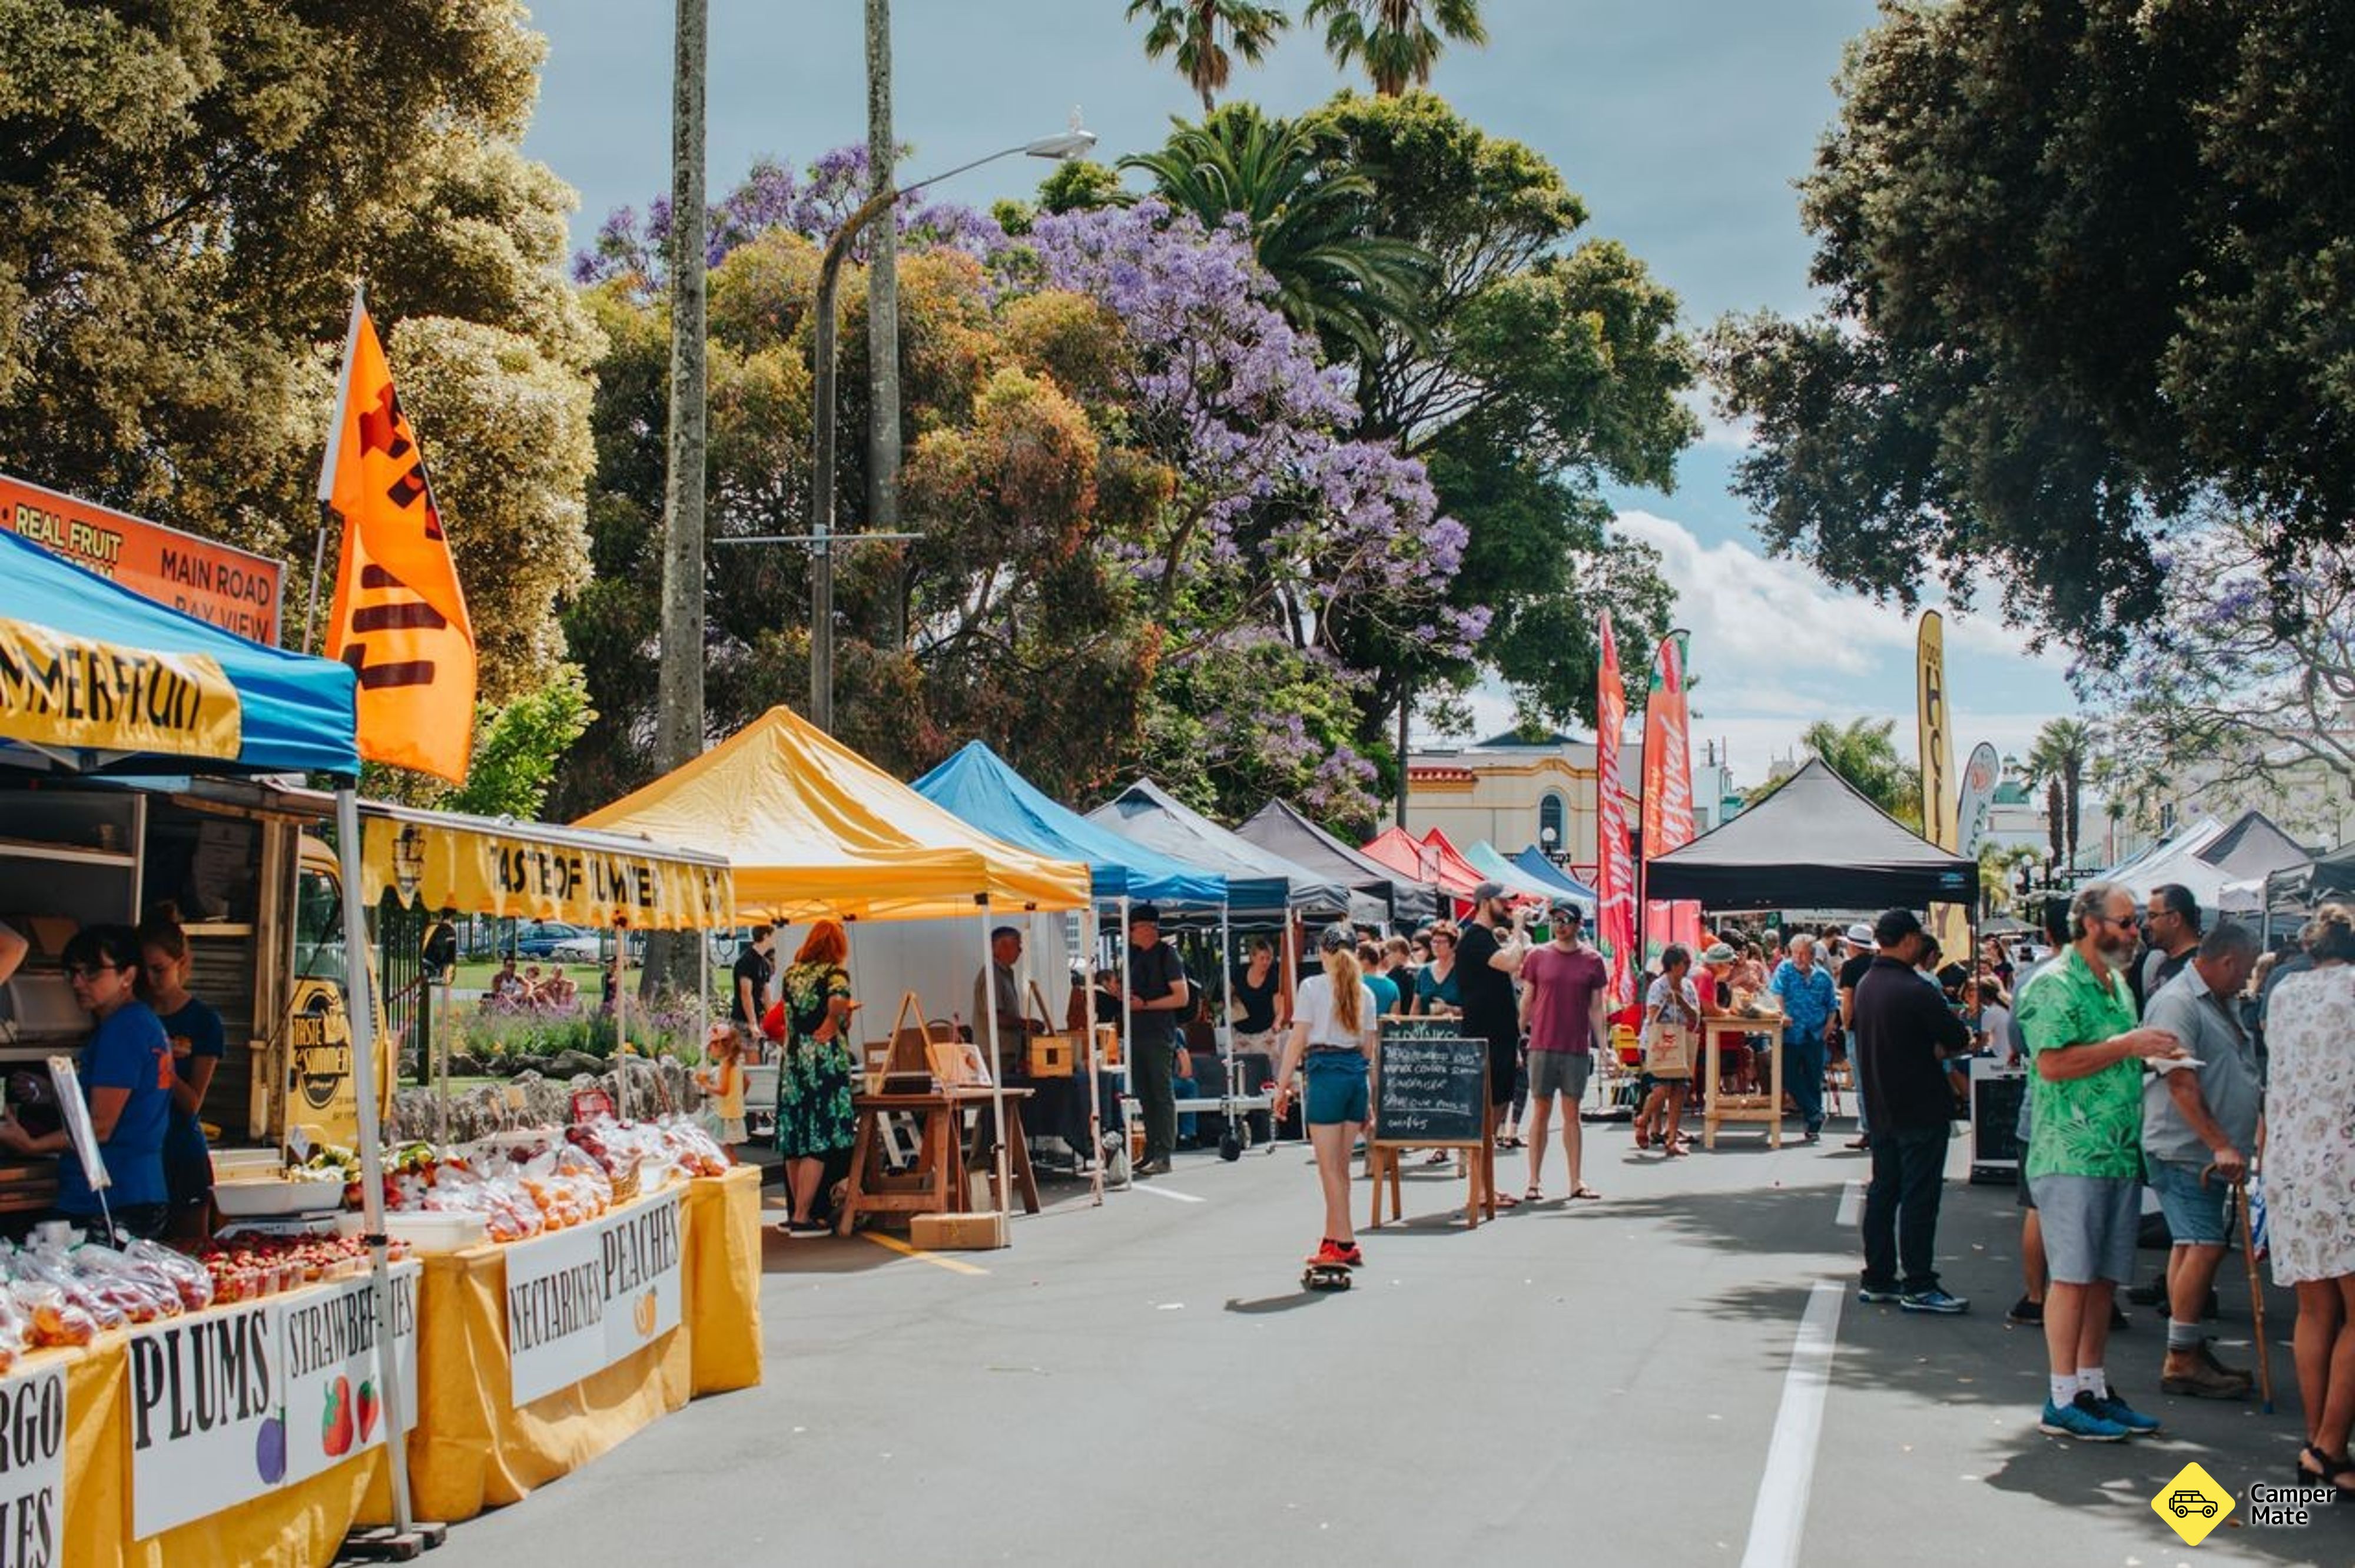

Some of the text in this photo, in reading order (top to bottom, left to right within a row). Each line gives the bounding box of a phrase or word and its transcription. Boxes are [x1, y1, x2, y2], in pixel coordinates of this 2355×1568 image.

[15, 503, 65, 549] REAL
[68, 519, 122, 564] FRUIT
[161, 547, 211, 591] MAIN
[217, 564, 270, 606] ROAD
[220, 607, 269, 643] VIEW
[554, 855, 582, 900] OF
[602, 1200, 679, 1303] PEACHES
[289, 1273, 413, 1379] STRAWBEIES
[510, 1260, 602, 1355] NECTARINES
[130, 1308, 270, 1451] PLUMS
